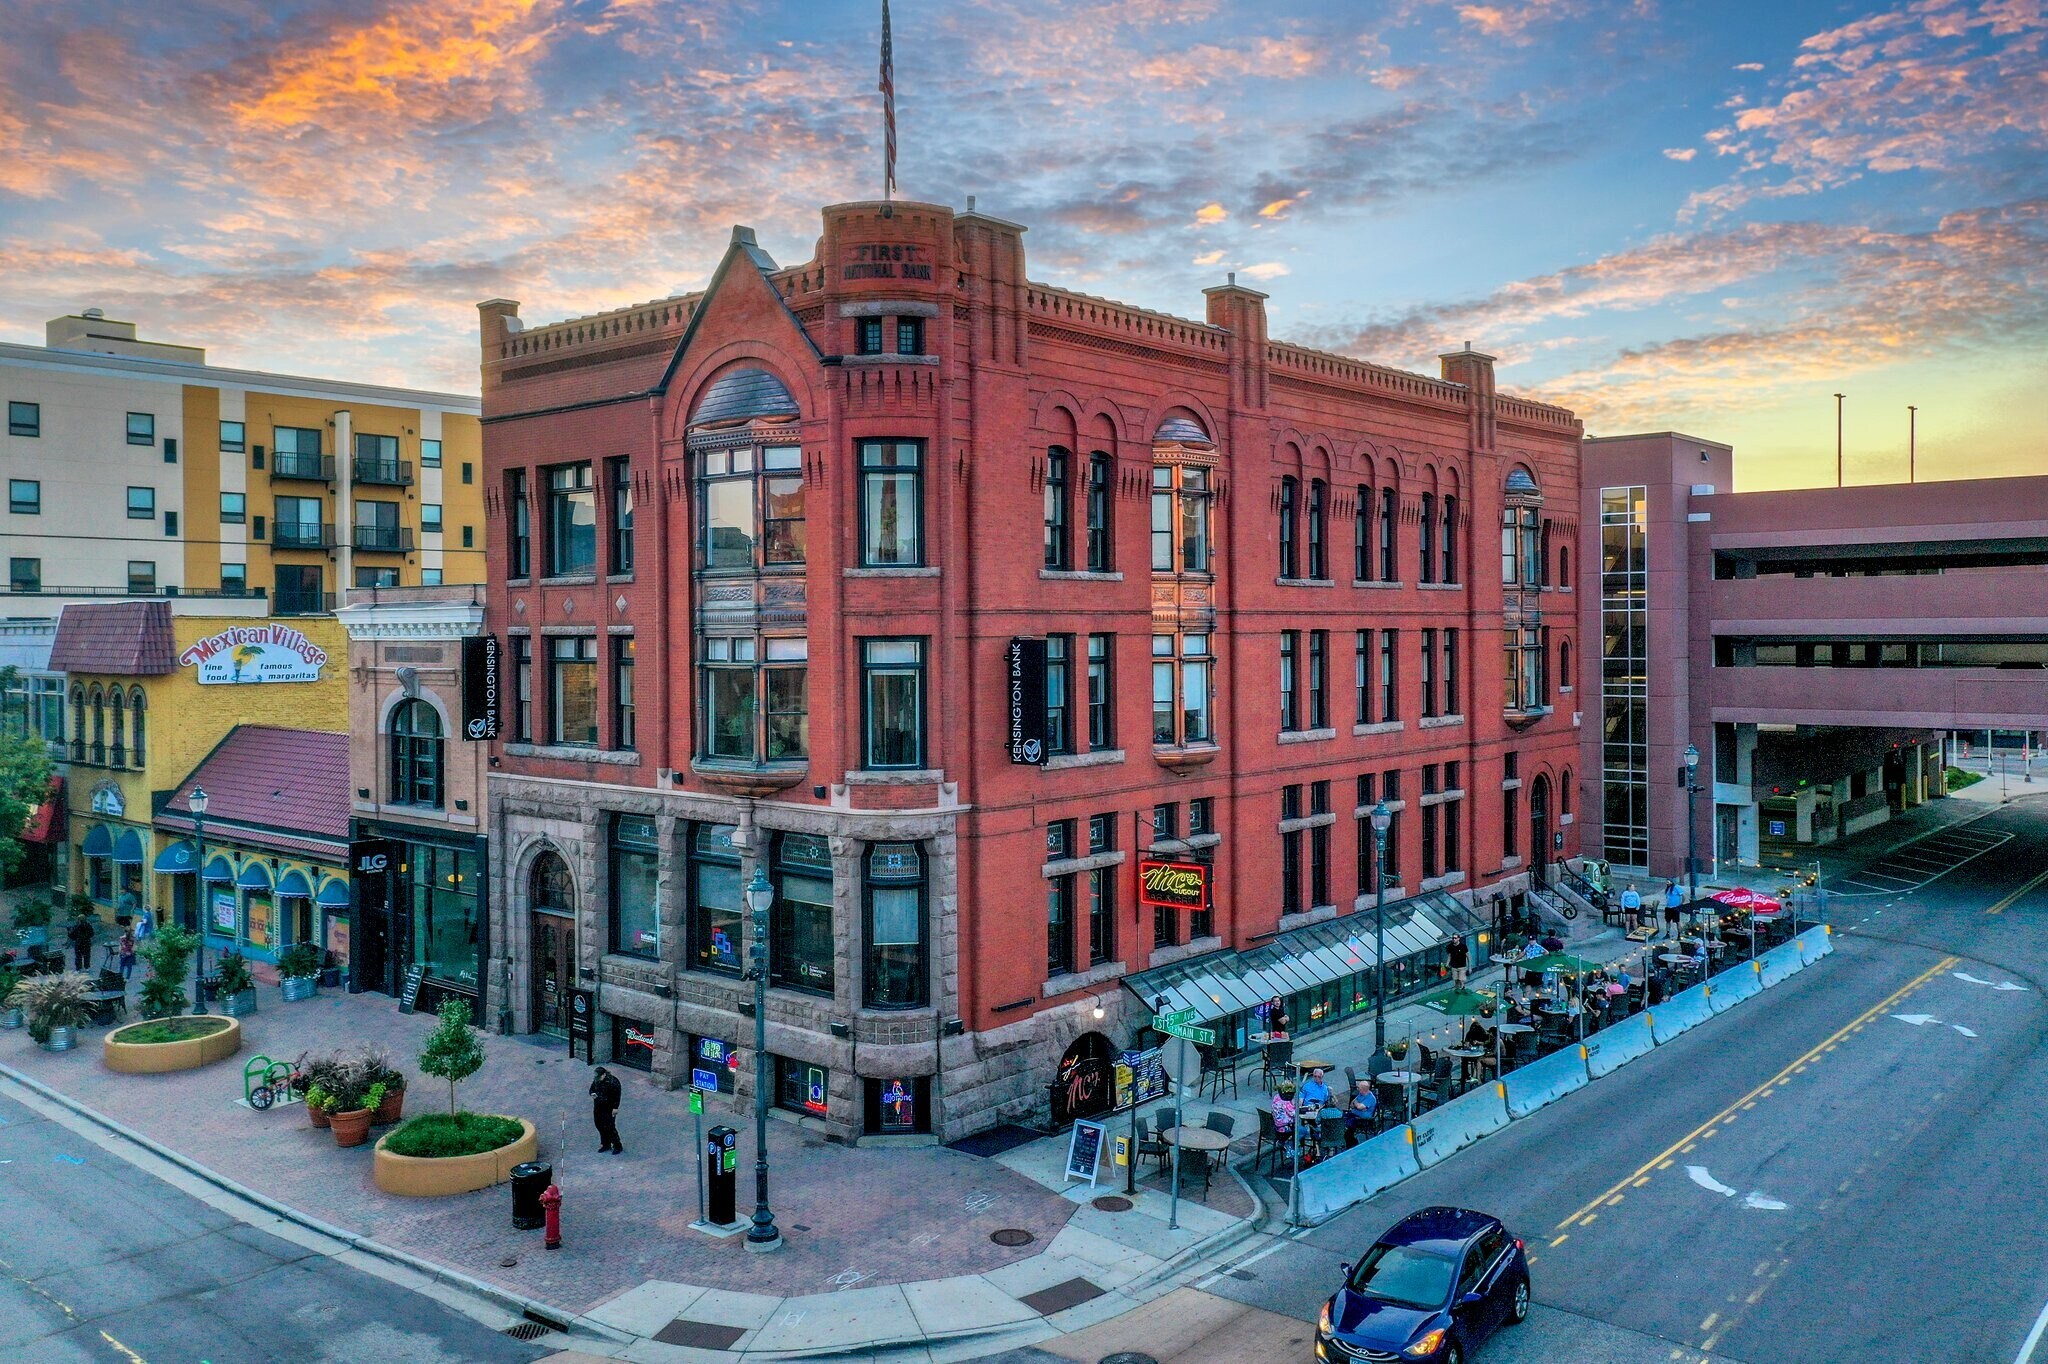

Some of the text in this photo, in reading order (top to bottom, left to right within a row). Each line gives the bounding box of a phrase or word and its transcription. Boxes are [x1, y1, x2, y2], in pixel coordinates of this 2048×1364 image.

[857, 244, 918, 262] FIRST
[843, 262, 932, 281] NATIONAL BANK
[180, 624, 327, 666] Mexican Village
[204, 663, 223, 671] fine
[260, 662, 293, 670] famous
[206, 673, 228, 681] food
[268, 671, 317, 681] margaritas
[486, 638, 496, 738] KENSINGTON BANK
[1011, 643, 1022, 762] KENSINGTON BANK
[357, 853, 388, 871] JLG
[1173, 888, 1200, 896] DUGOUT
[1157, 1019, 1165, 1030] ST
[1199, 1031, 1208, 1042] ST
[699, 1071, 710, 1080] PAY
[695, 1079, 715, 1091] STATION
